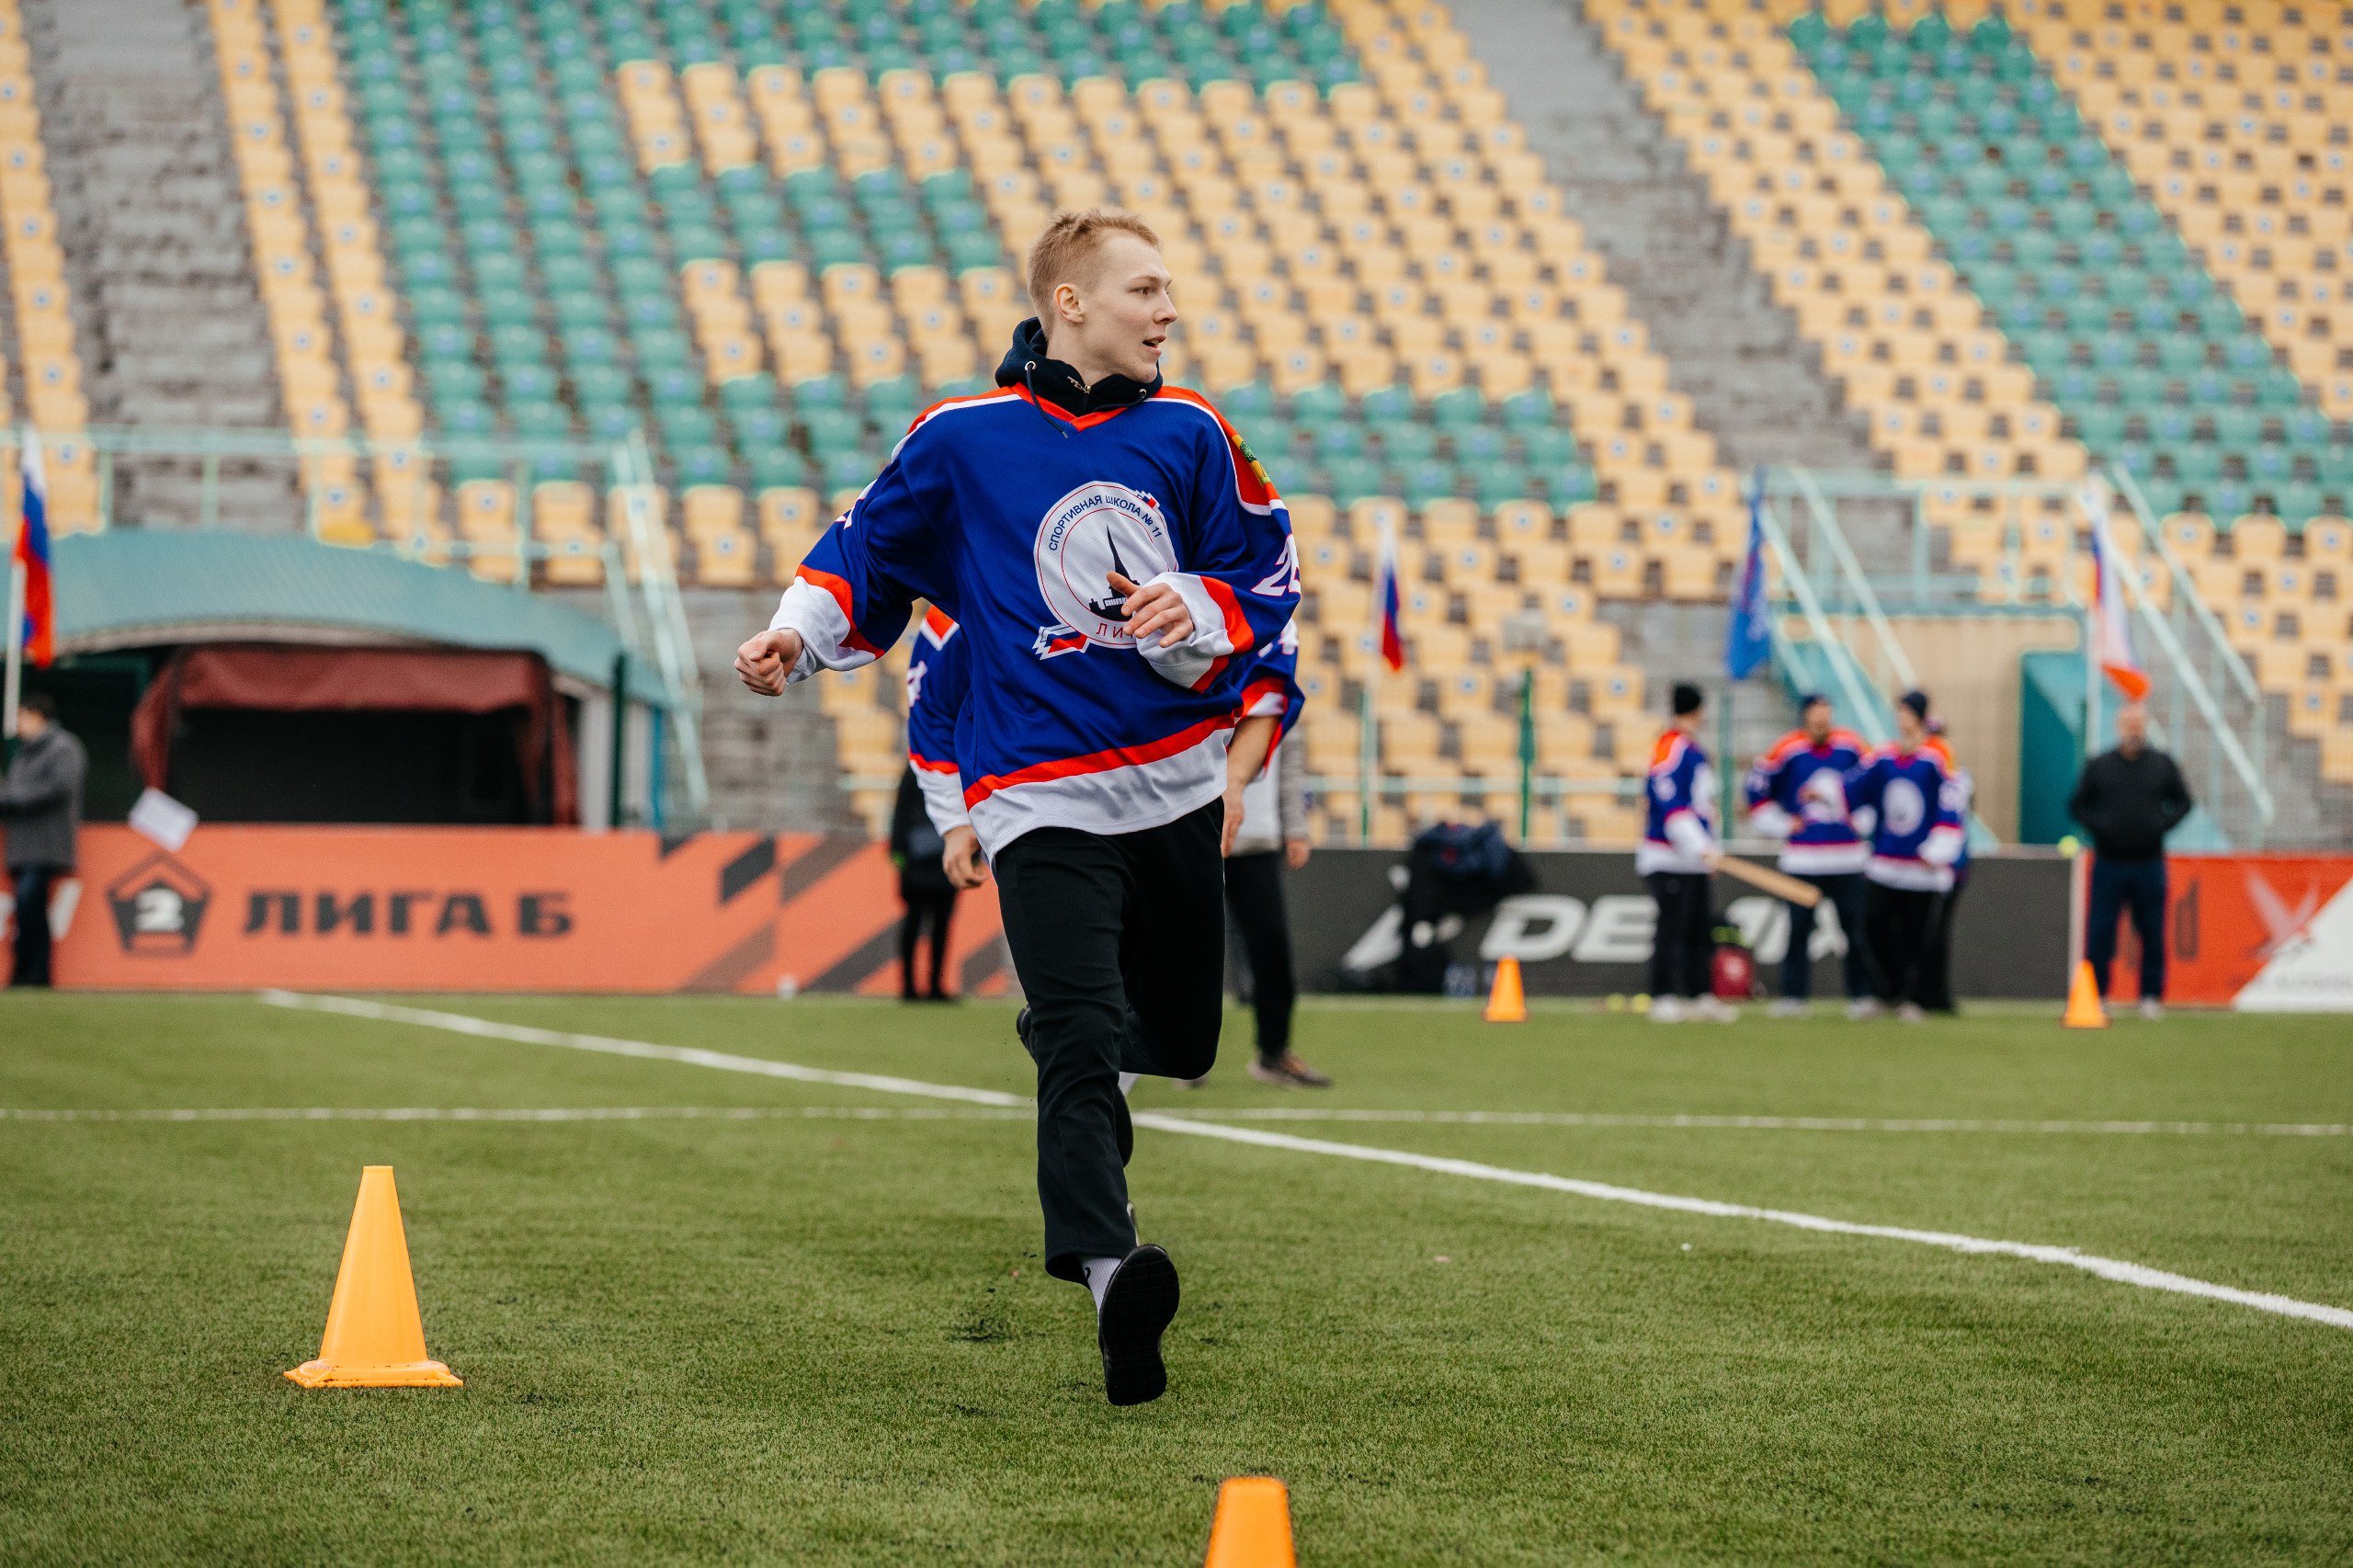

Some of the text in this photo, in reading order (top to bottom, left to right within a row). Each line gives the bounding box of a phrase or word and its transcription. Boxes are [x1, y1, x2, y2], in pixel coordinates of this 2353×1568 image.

[1049, 494, 1163, 551] СПОРТИВНАЯ ШКОЛА № 11
[134, 888, 184, 933] 2
[244, 888, 574, 937] ЛИГА Б
